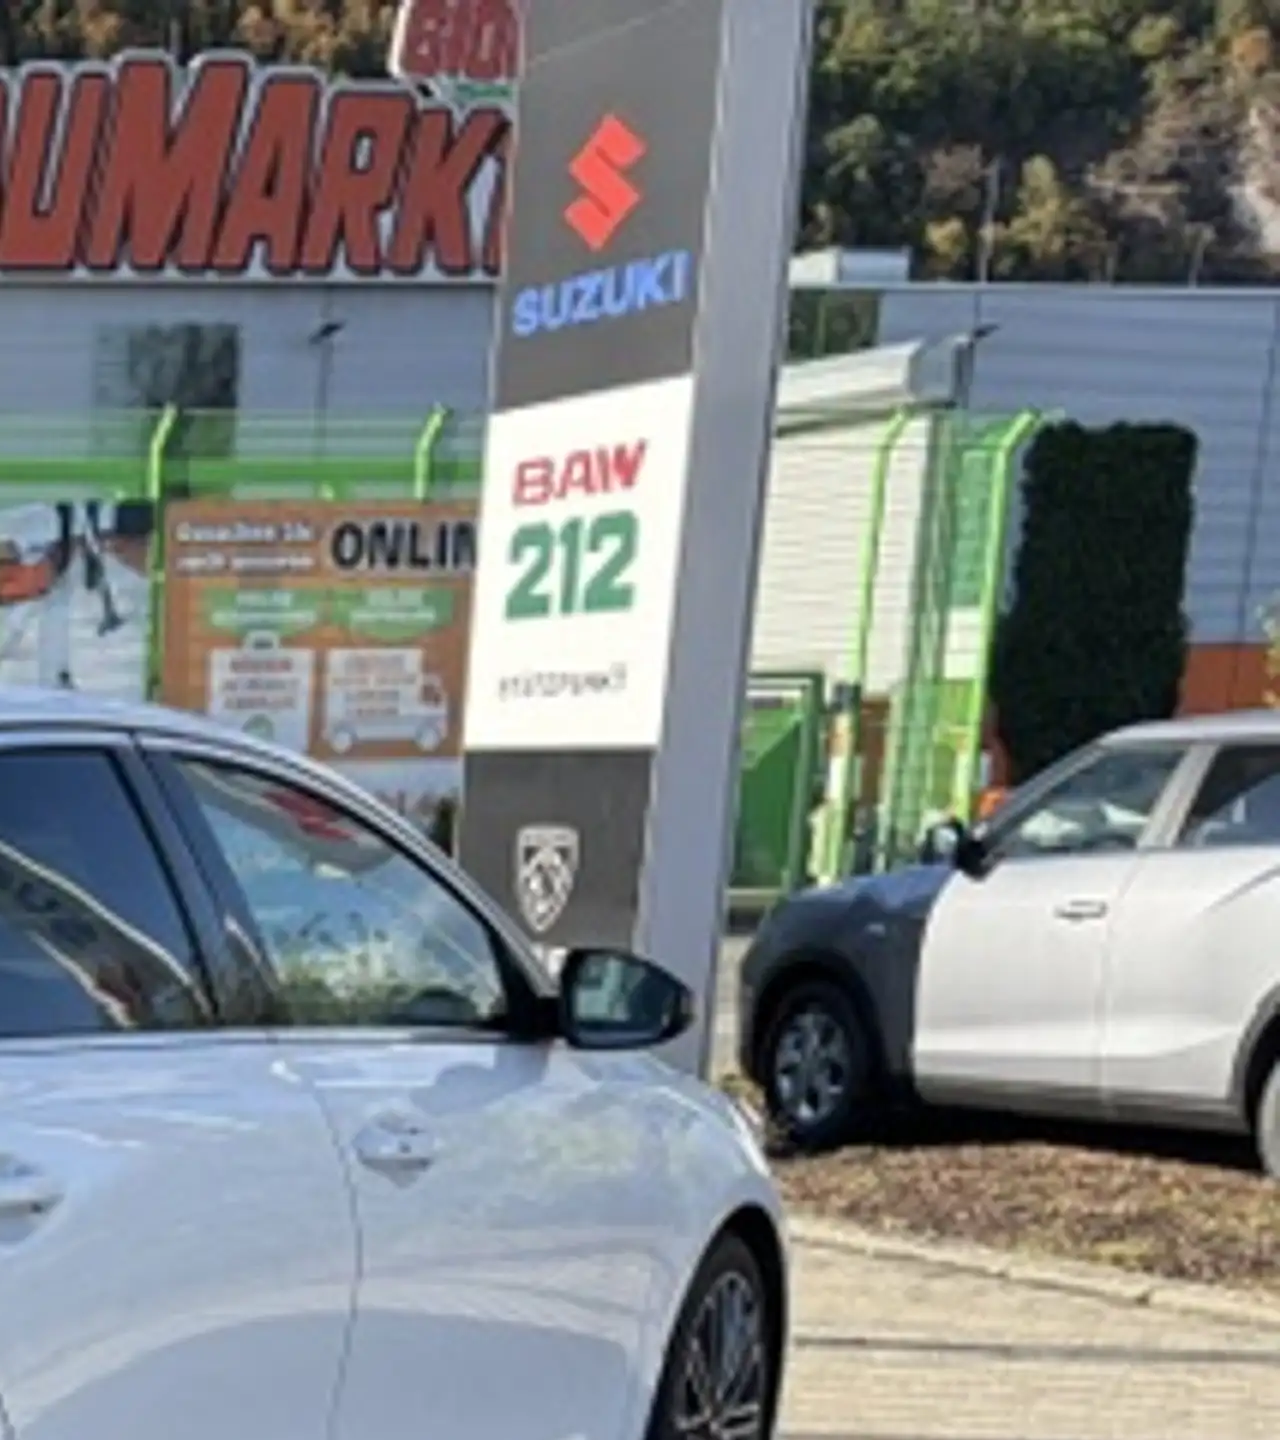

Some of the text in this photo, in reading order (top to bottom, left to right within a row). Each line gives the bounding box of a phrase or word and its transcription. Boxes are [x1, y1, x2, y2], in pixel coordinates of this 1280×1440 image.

[512, 249, 691, 338] SUZUKI
[511, 436, 648, 507] BAW
[504, 510, 639, 622] 212
